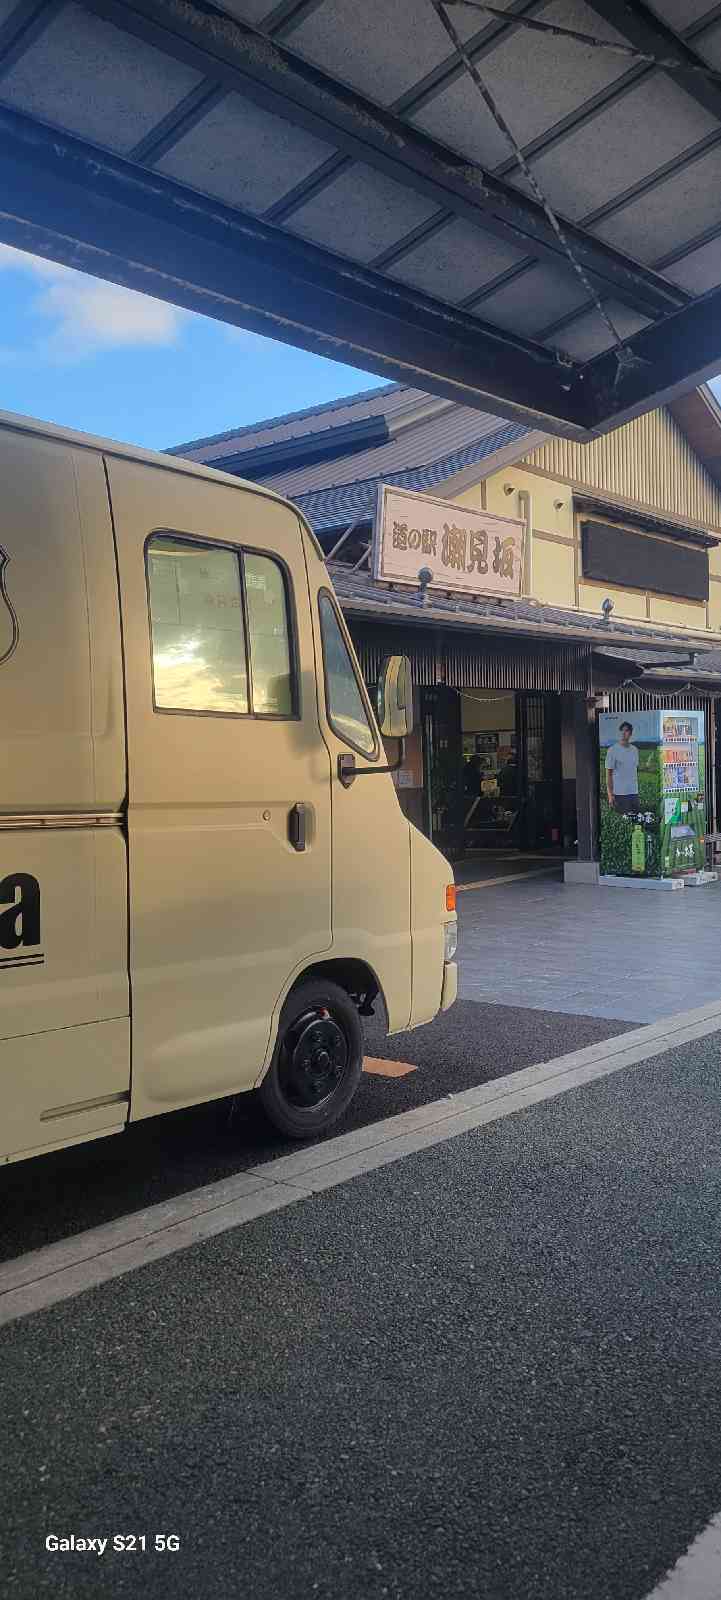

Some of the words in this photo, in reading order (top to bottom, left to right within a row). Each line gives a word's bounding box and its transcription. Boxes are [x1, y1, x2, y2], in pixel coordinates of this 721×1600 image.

[392, 521, 437, 556] 道の駅
[441, 522, 515, 579] 潮見坂
